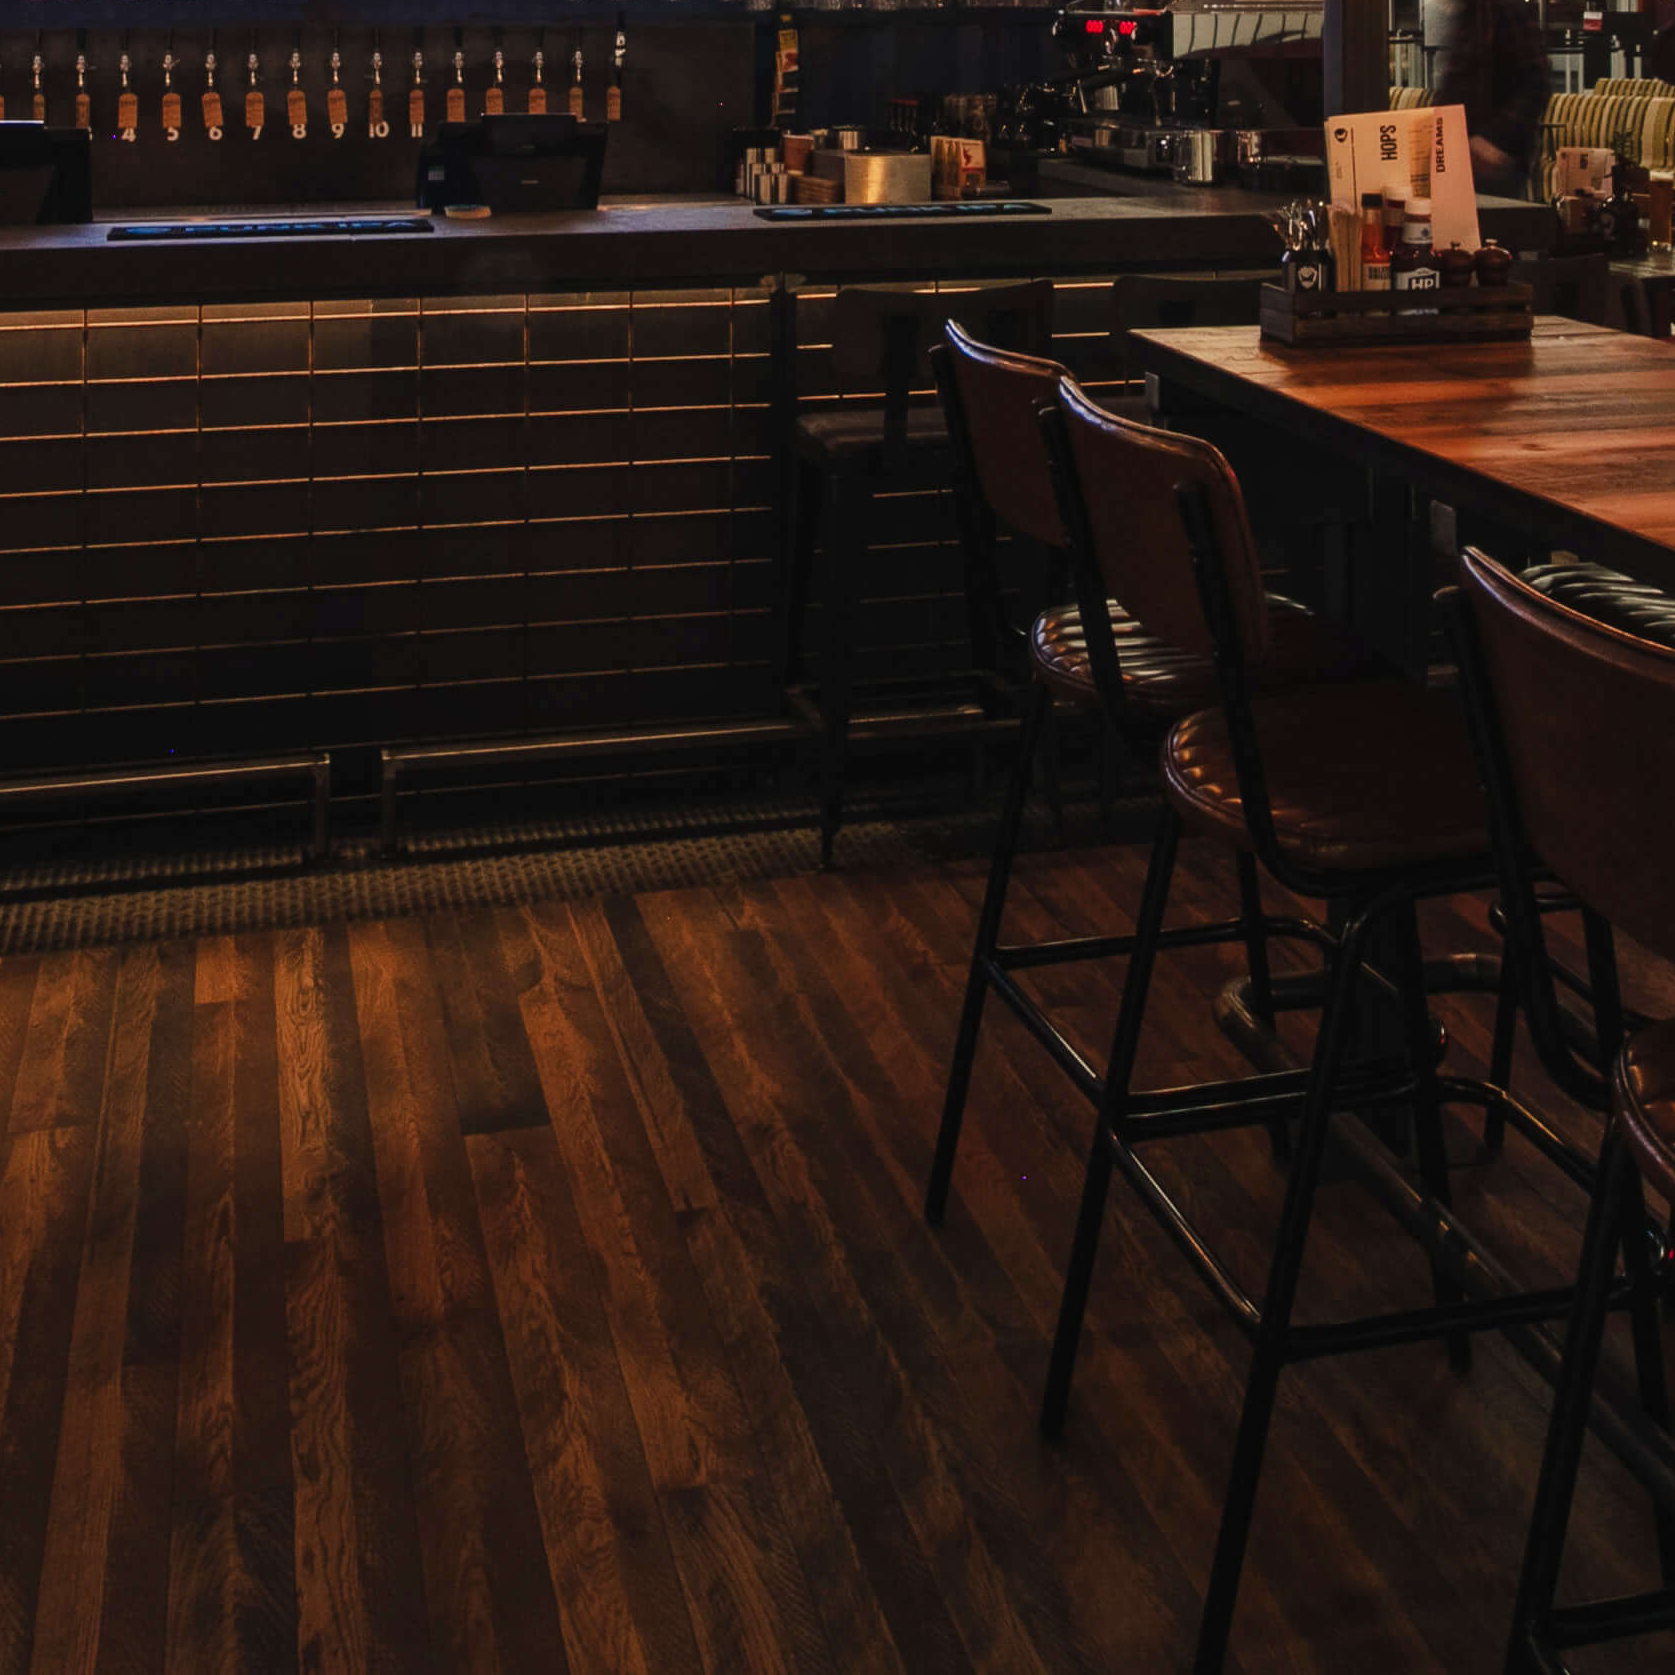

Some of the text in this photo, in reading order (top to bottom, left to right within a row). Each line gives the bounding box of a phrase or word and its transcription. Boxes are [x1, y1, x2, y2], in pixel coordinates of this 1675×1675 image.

[120, 120, 424, 142] 4 5 6 7 8 9 10 11
[1379, 124, 1399, 162] HOPS
[1435, 117, 1446, 174] DREAMS
[1410, 277, 1434, 290] HP
